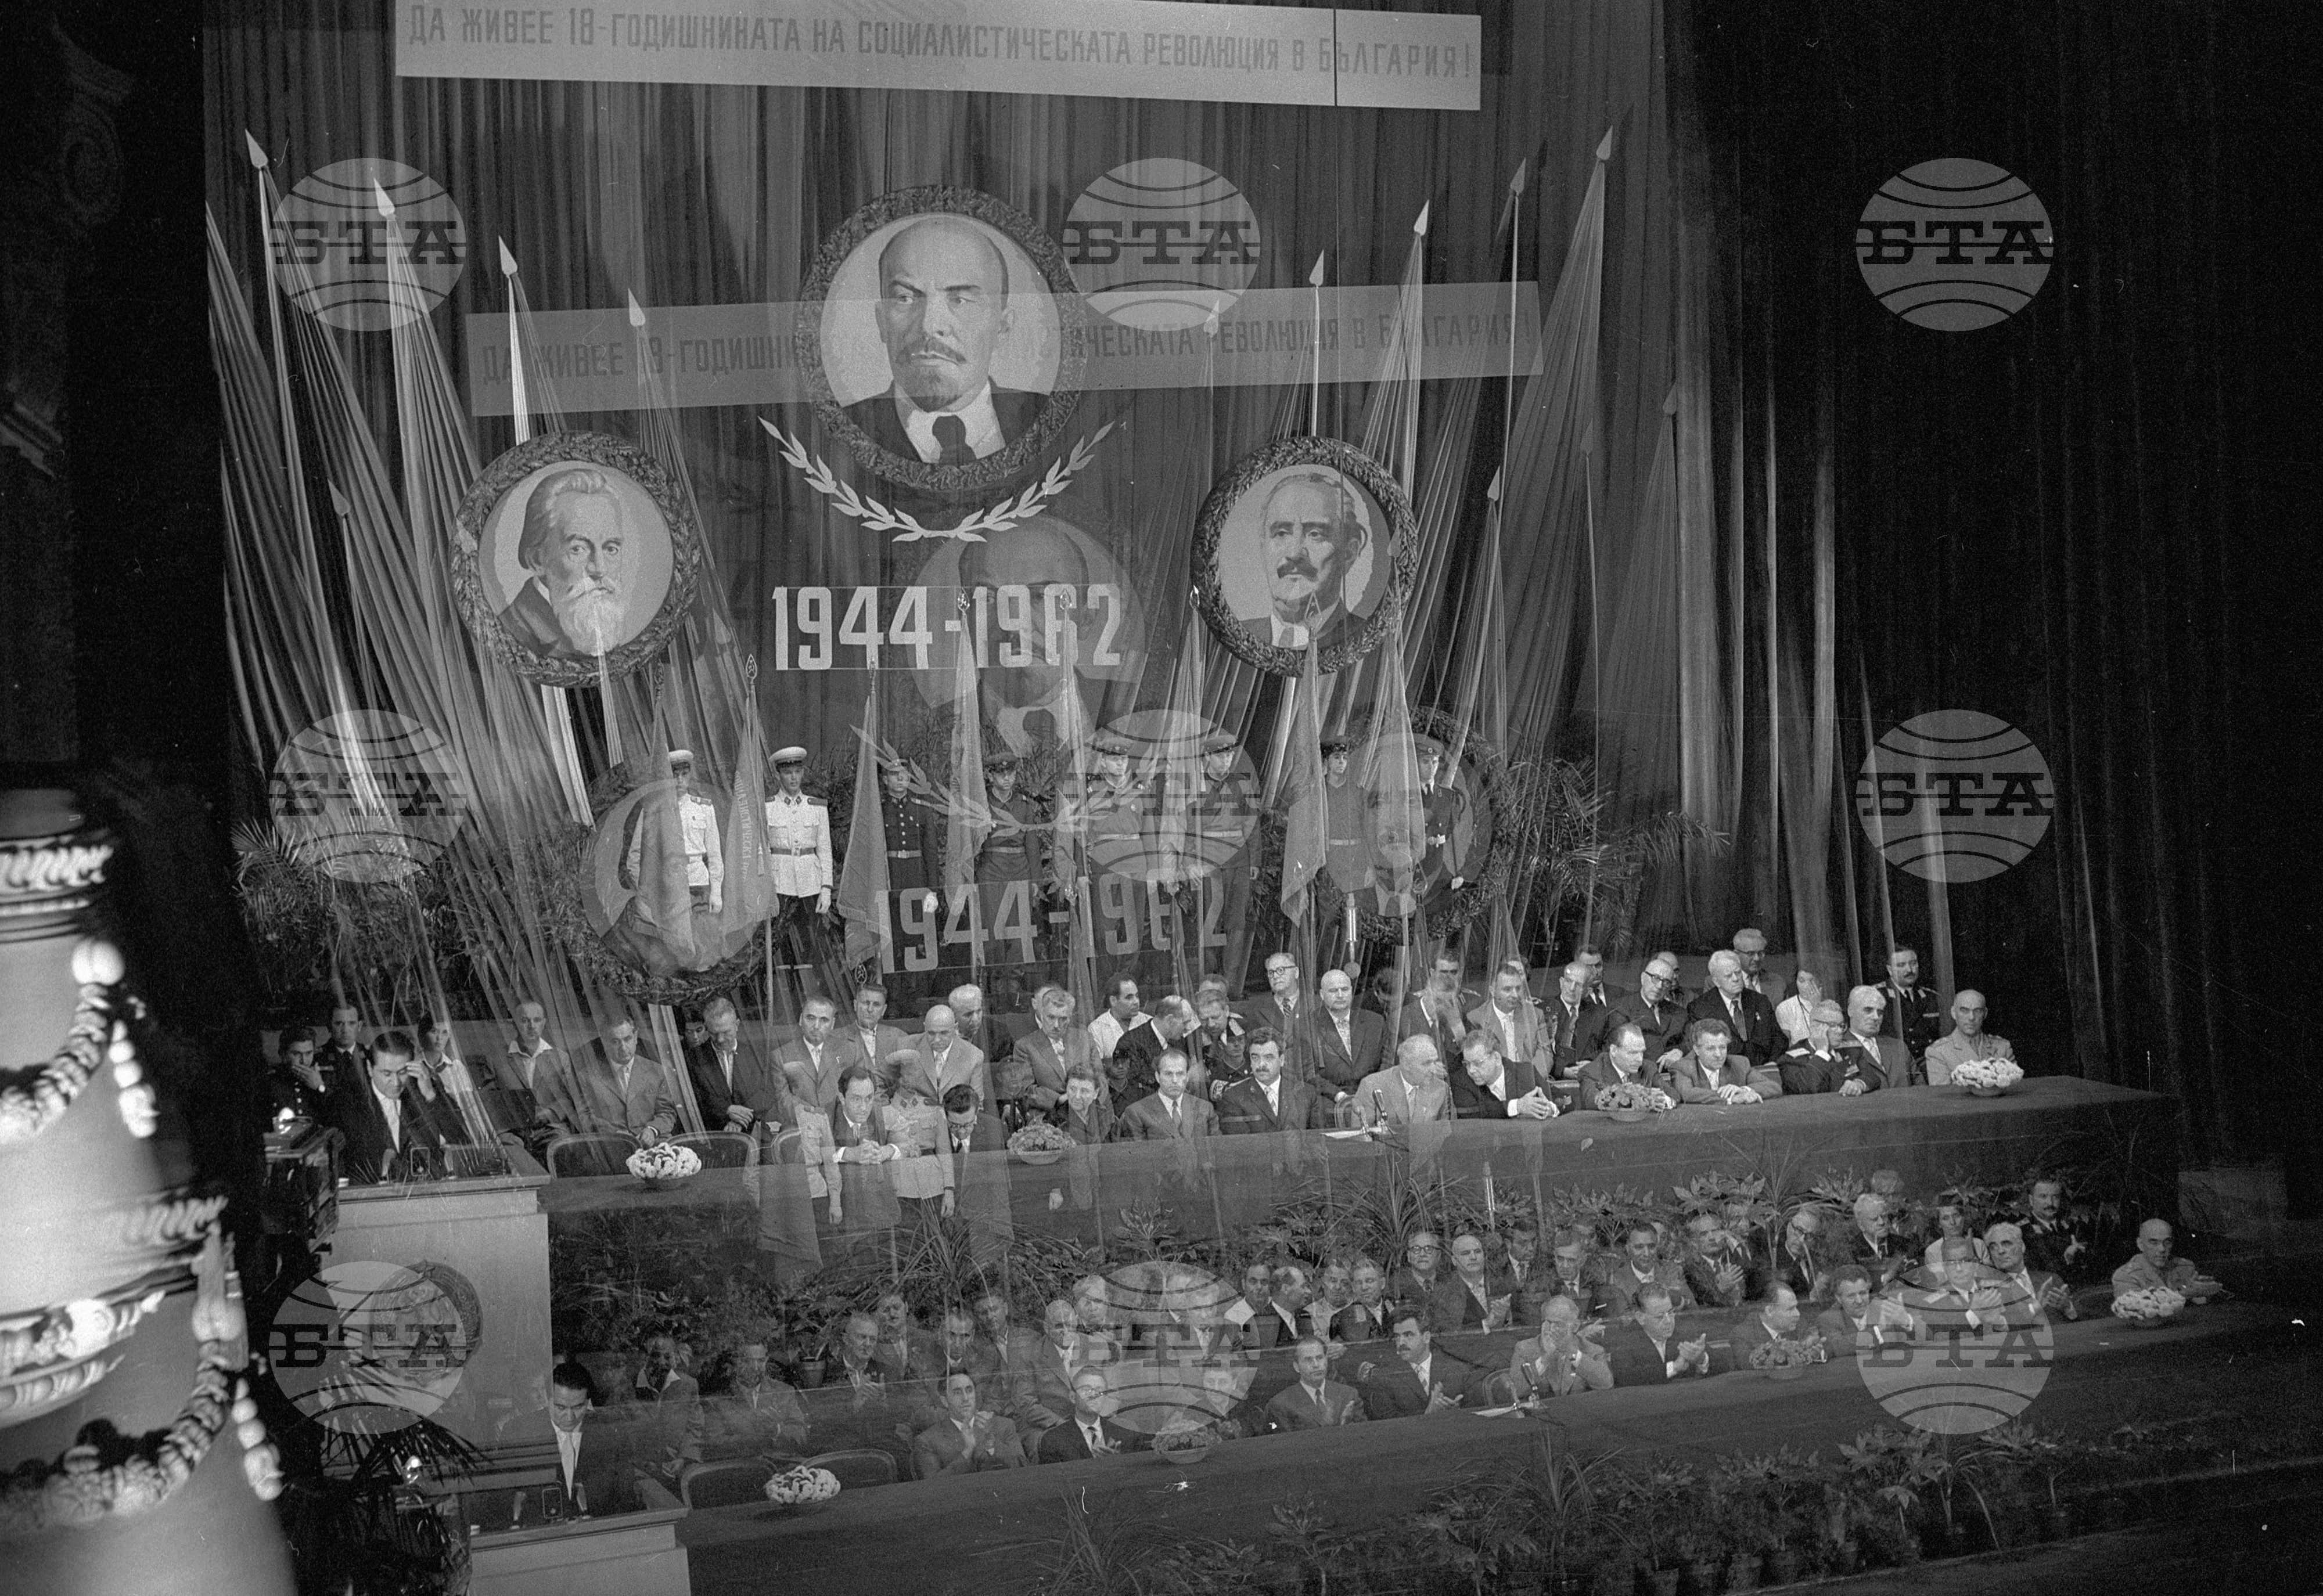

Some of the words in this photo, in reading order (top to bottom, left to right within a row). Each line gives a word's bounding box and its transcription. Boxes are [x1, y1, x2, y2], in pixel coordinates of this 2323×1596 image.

[409, 5, 445, 46] ДА
[462, 8, 553, 44] ЖИВЕЕ
[569, 8, 801, 52] 18-ГОДИШНИНАТА
[813, 18, 845, 53] НА
[858, 20, 1131, 64] СОЦИАЛИСТИЧЕСКАТА
[1144, 33, 1278, 73] РЕВОЛЮЦИЯ
[1292, 39, 1305, 71] В
[1354, 318, 1365, 350] В
[772, 583, 1121, 670] 1944-1962
